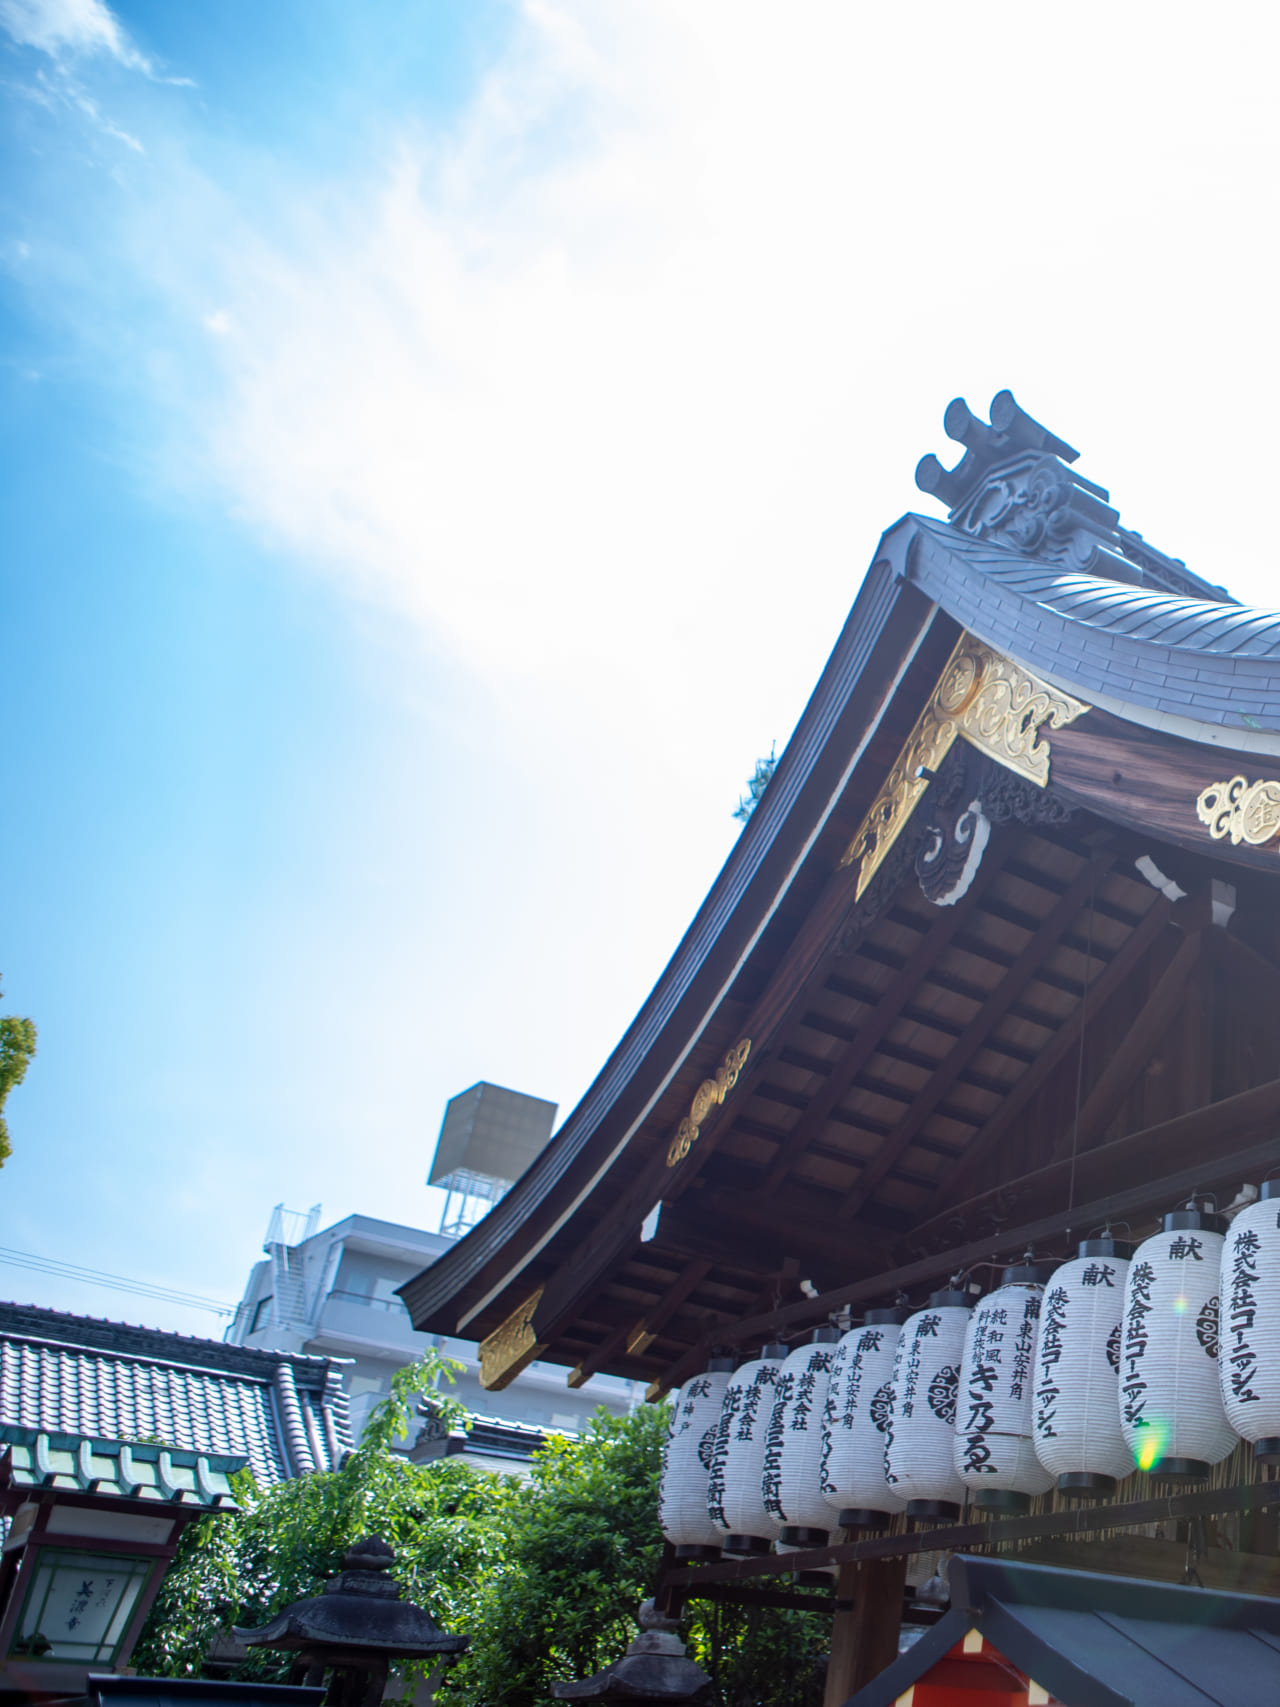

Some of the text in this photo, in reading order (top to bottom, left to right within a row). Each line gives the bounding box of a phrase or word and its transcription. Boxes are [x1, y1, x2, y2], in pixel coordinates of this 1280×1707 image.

[1169, 1236, 1203, 1261] 献
[1082, 1263, 1115, 1287] 献
[916, 1314, 942, 1337] 献
[857, 1331, 884, 1352] 献
[807, 1351, 835, 1373] 献
[1009, 1320, 1033, 1400] 東山安井角
[754, 1366, 779, 1385] 献
[902, 1339, 921, 1418] 東山安井角
[687, 1380, 712, 1399] 献
[791, 1372, 816, 1431] 株式会社
[842, 1353, 863, 1429] 東山安井角
[735, 1385, 762, 1441] 株式会社
